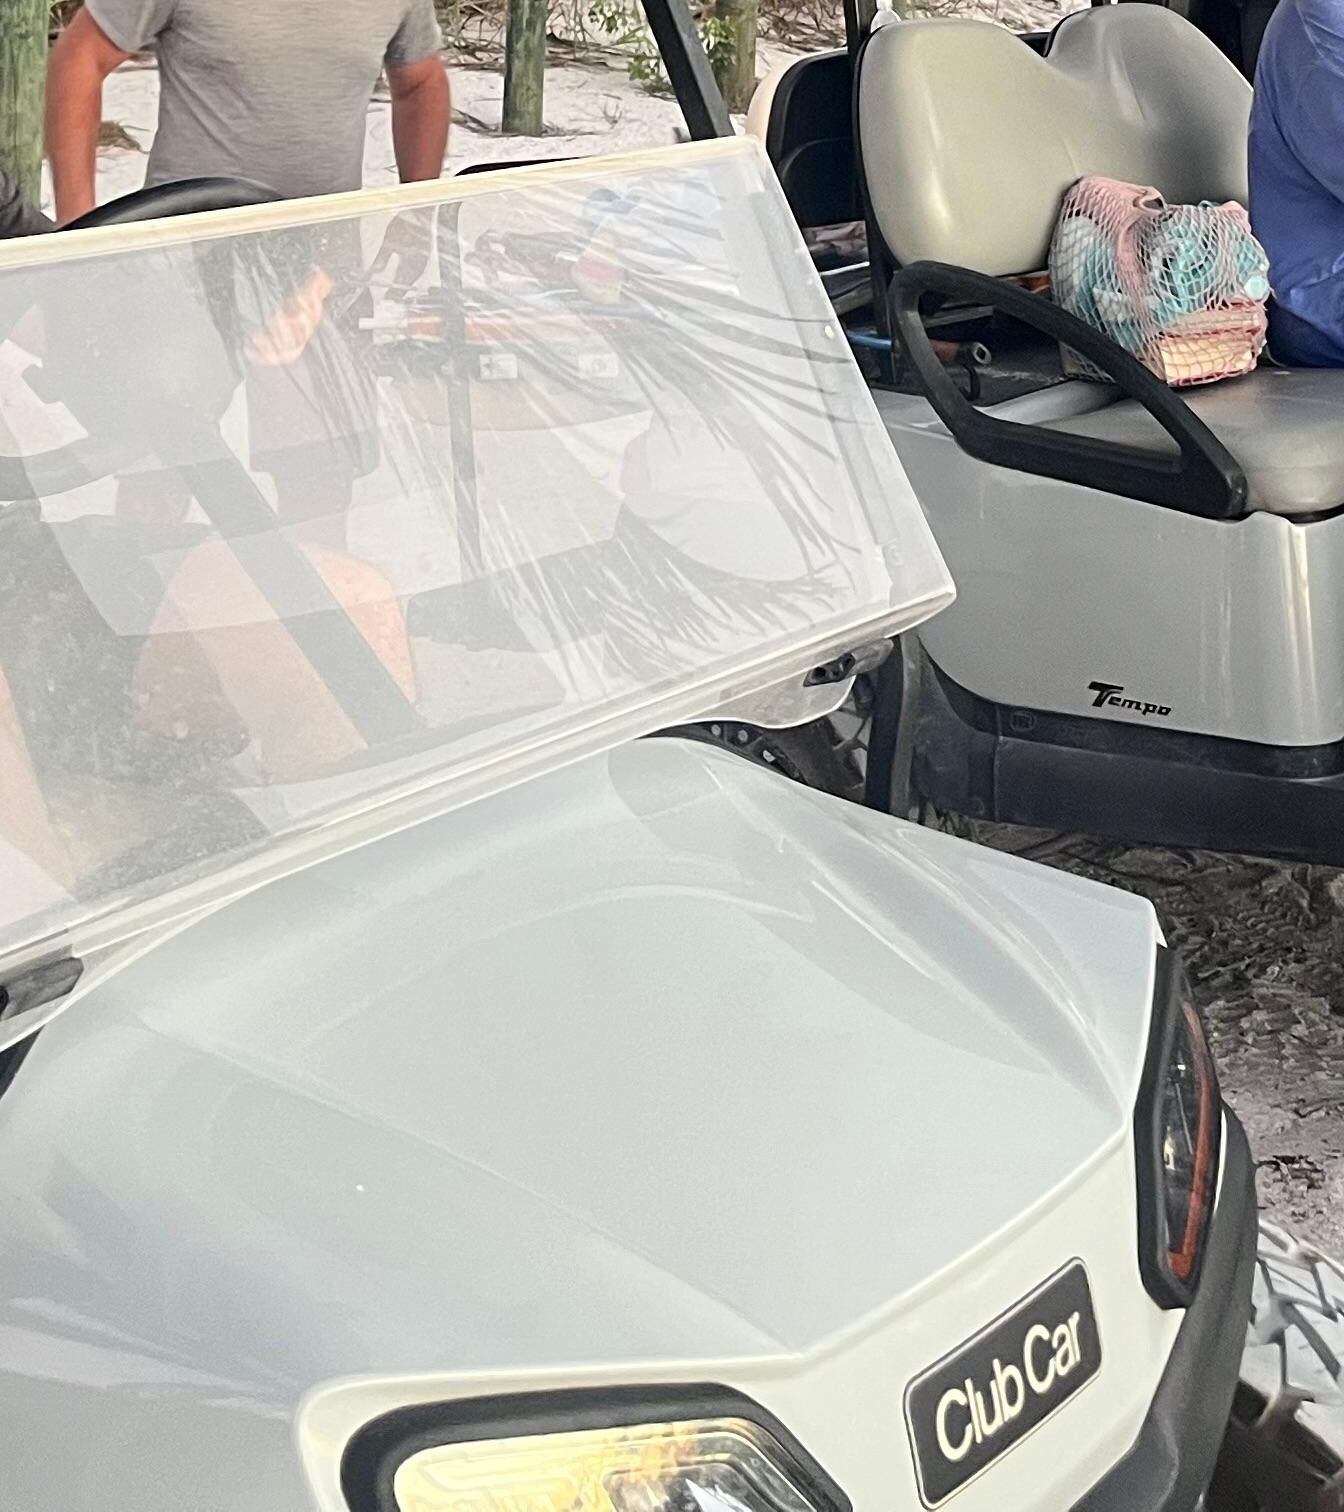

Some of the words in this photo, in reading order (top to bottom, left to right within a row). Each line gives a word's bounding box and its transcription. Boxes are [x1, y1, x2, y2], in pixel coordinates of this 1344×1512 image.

[1088, 681, 1172, 716] Tempo
[937, 1359, 1024, 1462] Club
[1023, 1311, 1082, 1394] Car
